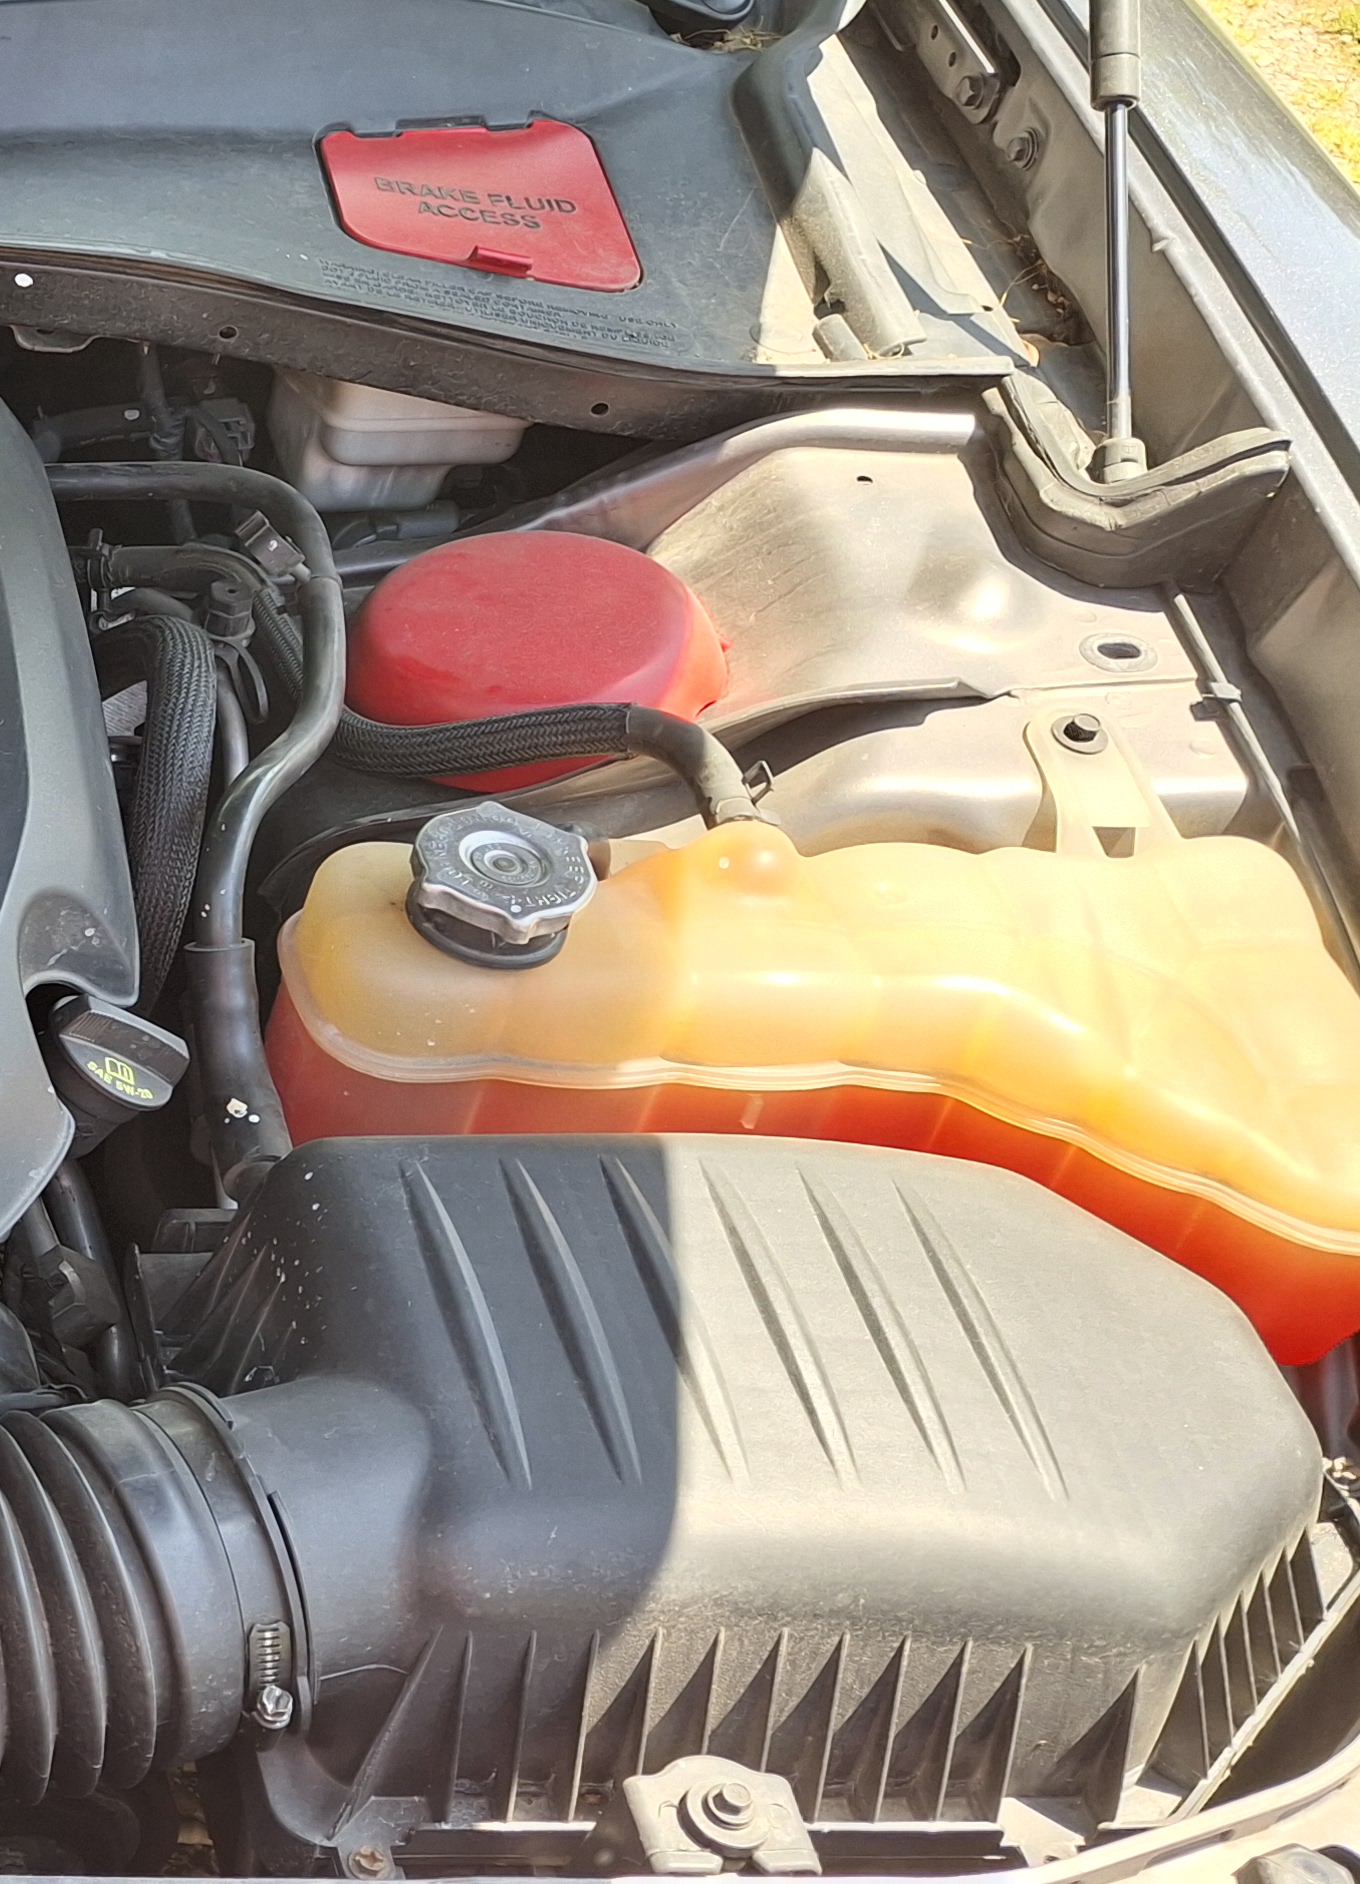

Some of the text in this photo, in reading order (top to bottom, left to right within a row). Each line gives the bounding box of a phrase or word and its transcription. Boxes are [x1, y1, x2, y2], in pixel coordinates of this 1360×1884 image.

[374, 176, 578, 215] BRAKE FLUID
[417, 200, 542, 230] ACCESS
[86, 1060, 113, 1085] SAE
